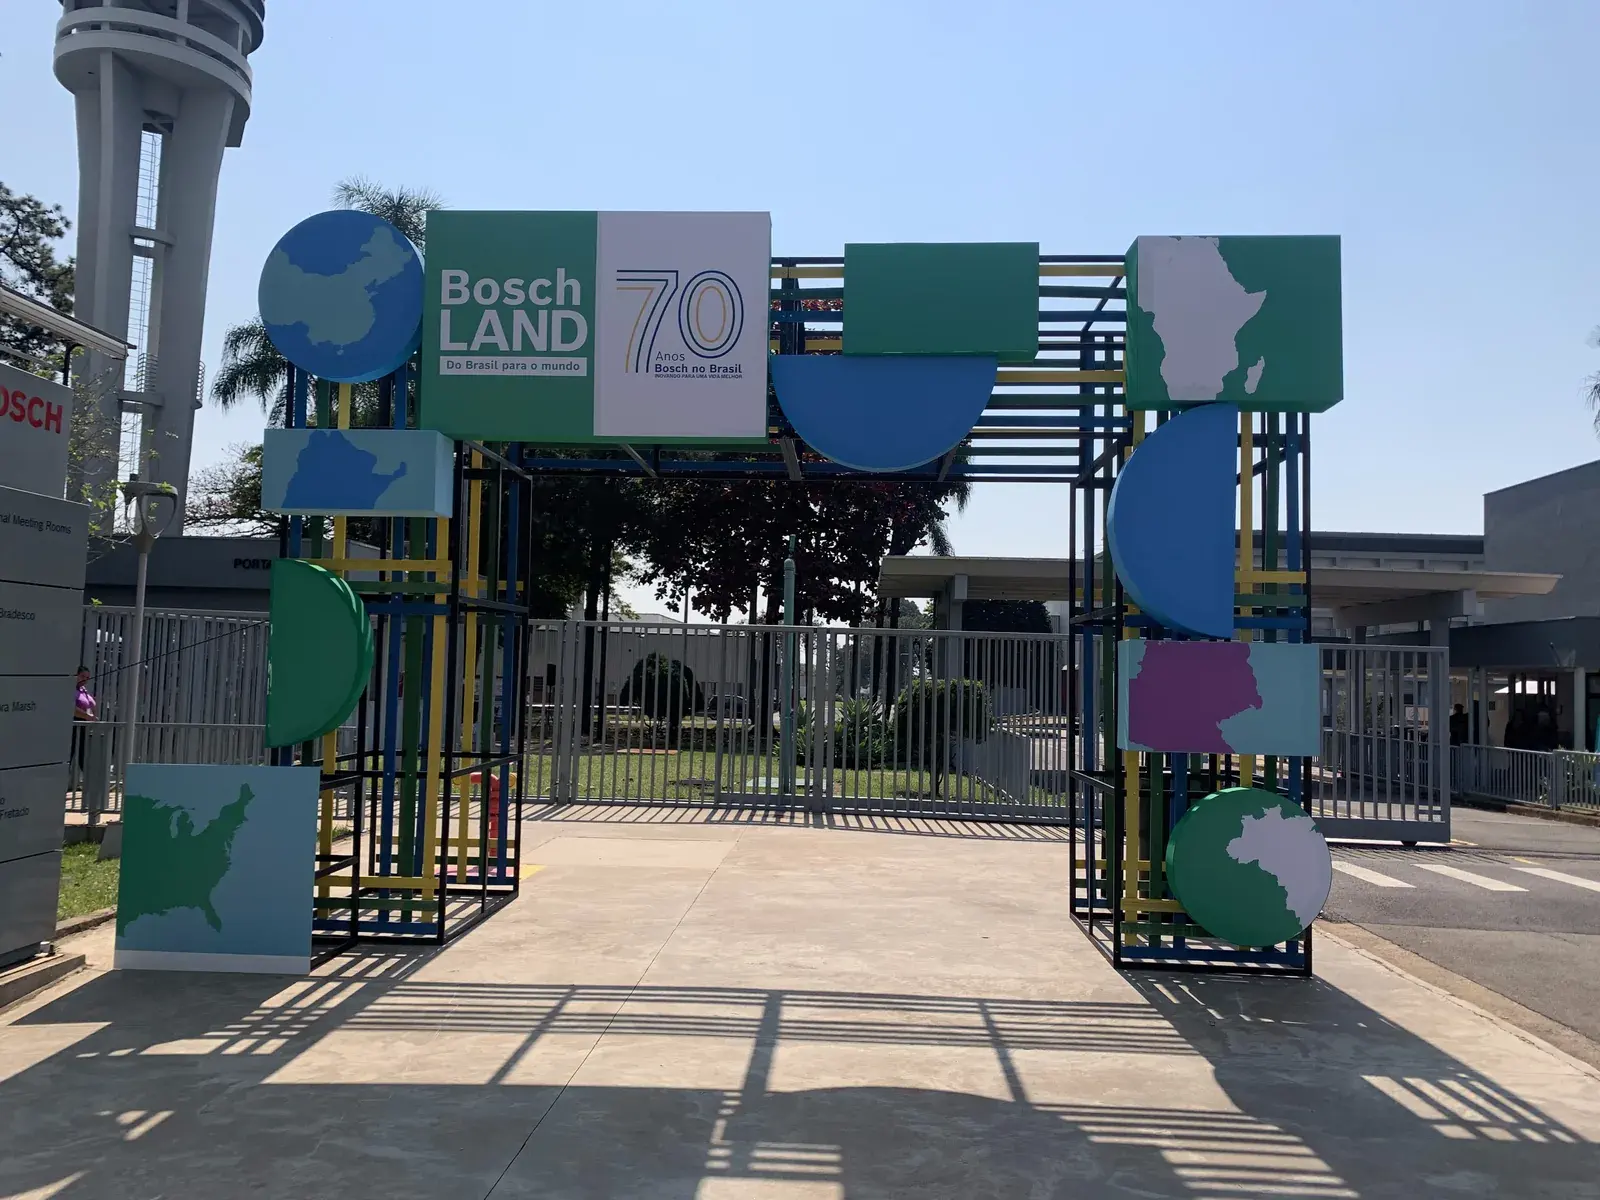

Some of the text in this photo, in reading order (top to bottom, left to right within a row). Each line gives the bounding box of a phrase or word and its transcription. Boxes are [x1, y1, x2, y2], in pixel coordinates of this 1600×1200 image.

[440, 267, 581, 306] Bosch
[616, 270, 744, 373] 70
[440, 309, 588, 352] LAND
[655, 351, 686, 362] Anos
[446, 360, 462, 370] Do
[465, 360, 498, 370] Brasil
[502, 361, 527, 371] para
[541, 361, 580, 371] mundo
[654, 363, 742, 374] Bosch no Brasil
[13, 514, 44, 532] Meeting
[45, 520, 72, 535] Rooms
[12, 700, 36, 713] Marsh
